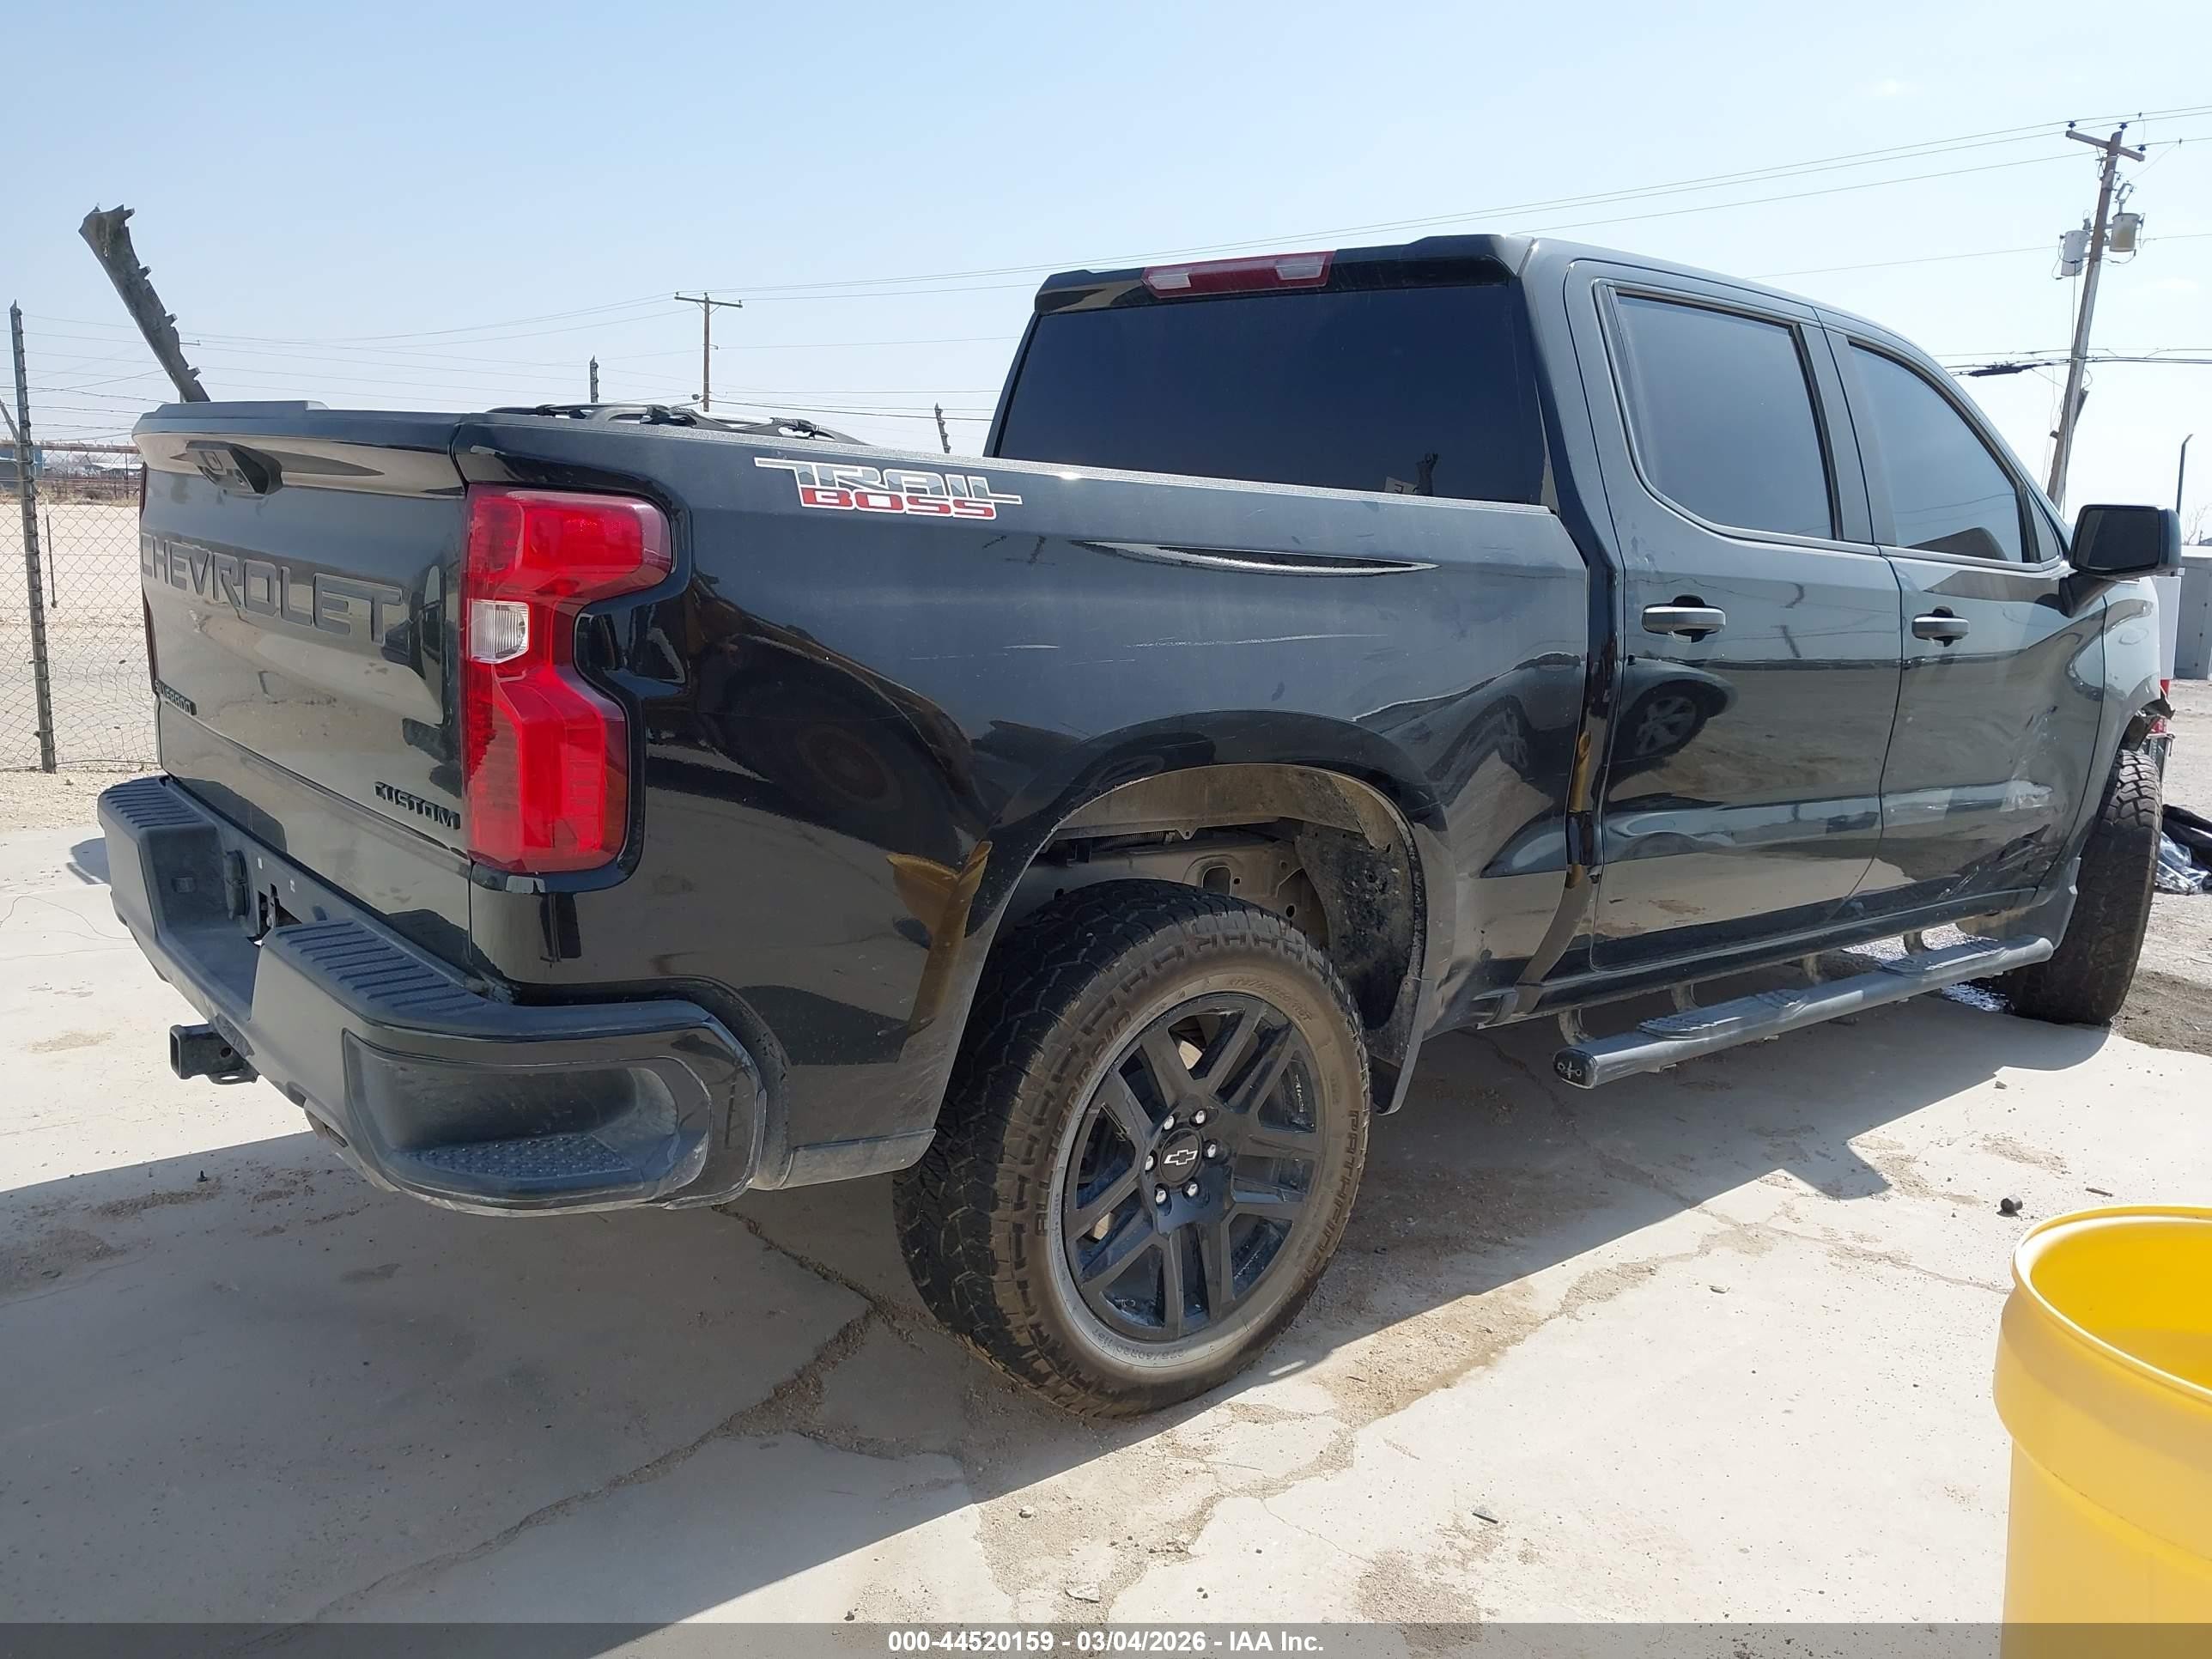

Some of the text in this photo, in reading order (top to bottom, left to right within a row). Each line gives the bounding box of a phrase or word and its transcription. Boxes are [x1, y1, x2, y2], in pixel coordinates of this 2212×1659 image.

[754, 457, 1023, 505] TRAIL
[799, 486, 997, 520] BOSS
[140, 532, 404, 646] CHEVROLET
[374, 781, 461, 830] CUSTOM
[1036, 1179, 1050, 1237] ALL
